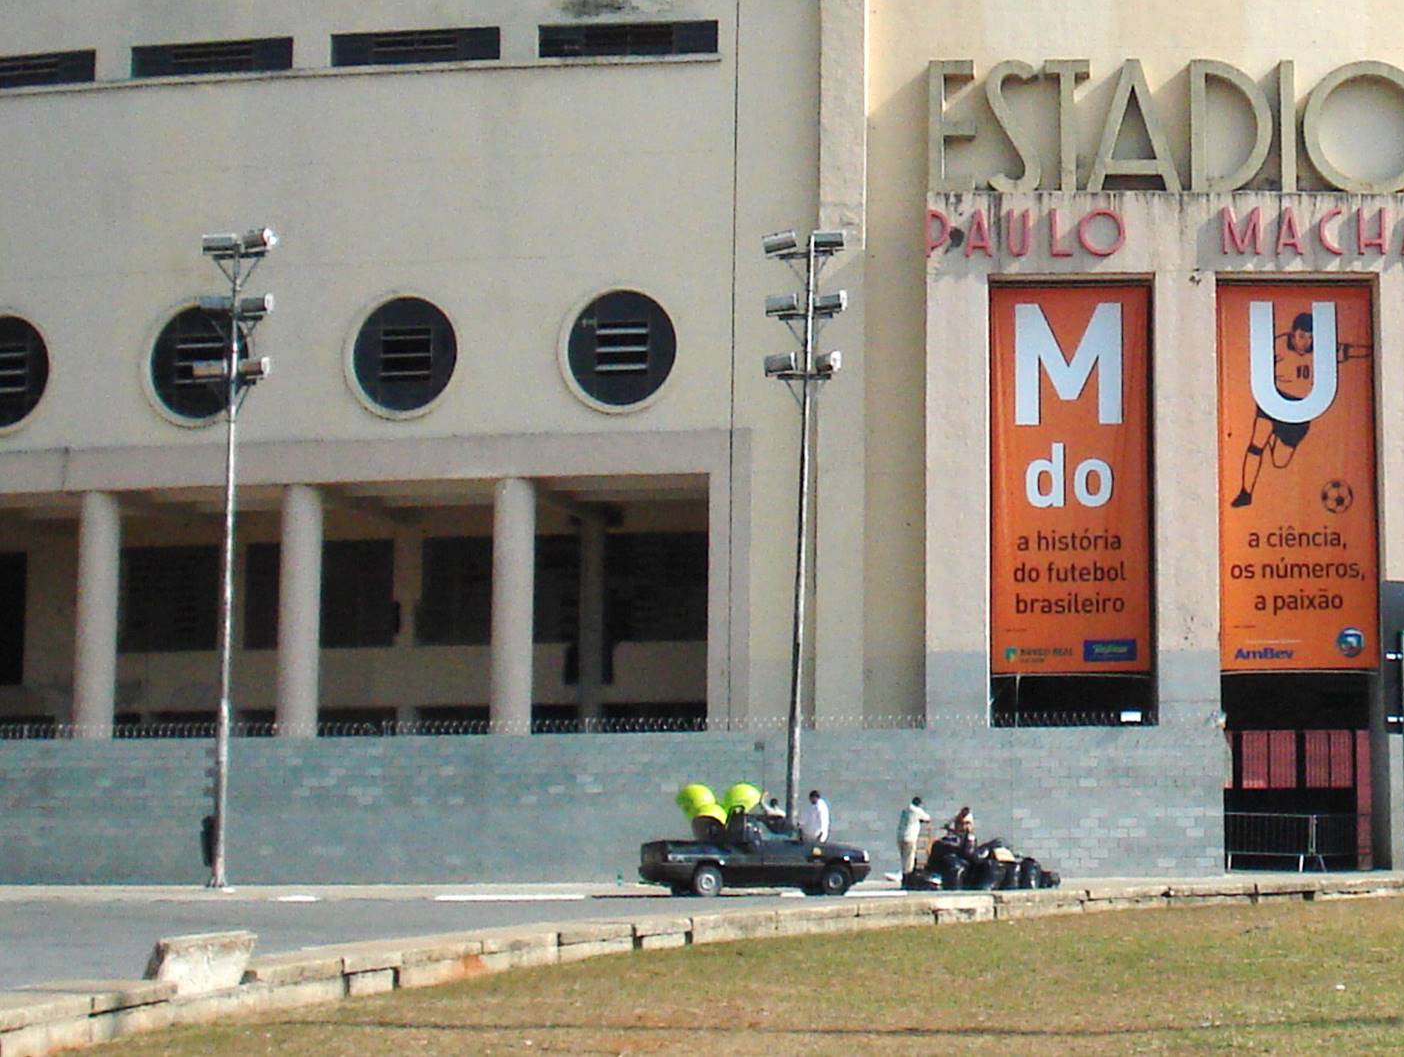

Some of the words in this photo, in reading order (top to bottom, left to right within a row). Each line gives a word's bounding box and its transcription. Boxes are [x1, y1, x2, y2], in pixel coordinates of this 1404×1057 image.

[925, 207, 1127, 258] PAULO
[1014, 302, 1124, 426] M
[1248, 301, 1339, 424] U
[1024, 442, 1114, 509] do
[1017, 535, 1029, 551] a
[1037, 528, 1122, 551] história
[1248, 532, 1260, 548] a
[1266, 525, 1347, 550] ciência,
[1013, 562, 1040, 582] do
[1047, 561, 1126, 582] futebol
[1230, 563, 1255, 580] os
[1262, 556, 1365, 581] números,
[1015, 592, 1125, 614] brasileiro
[1254, 595, 1266, 611] a
[1273, 588, 1343, 616] paixão
[1234, 647, 1294, 660] AmBev
